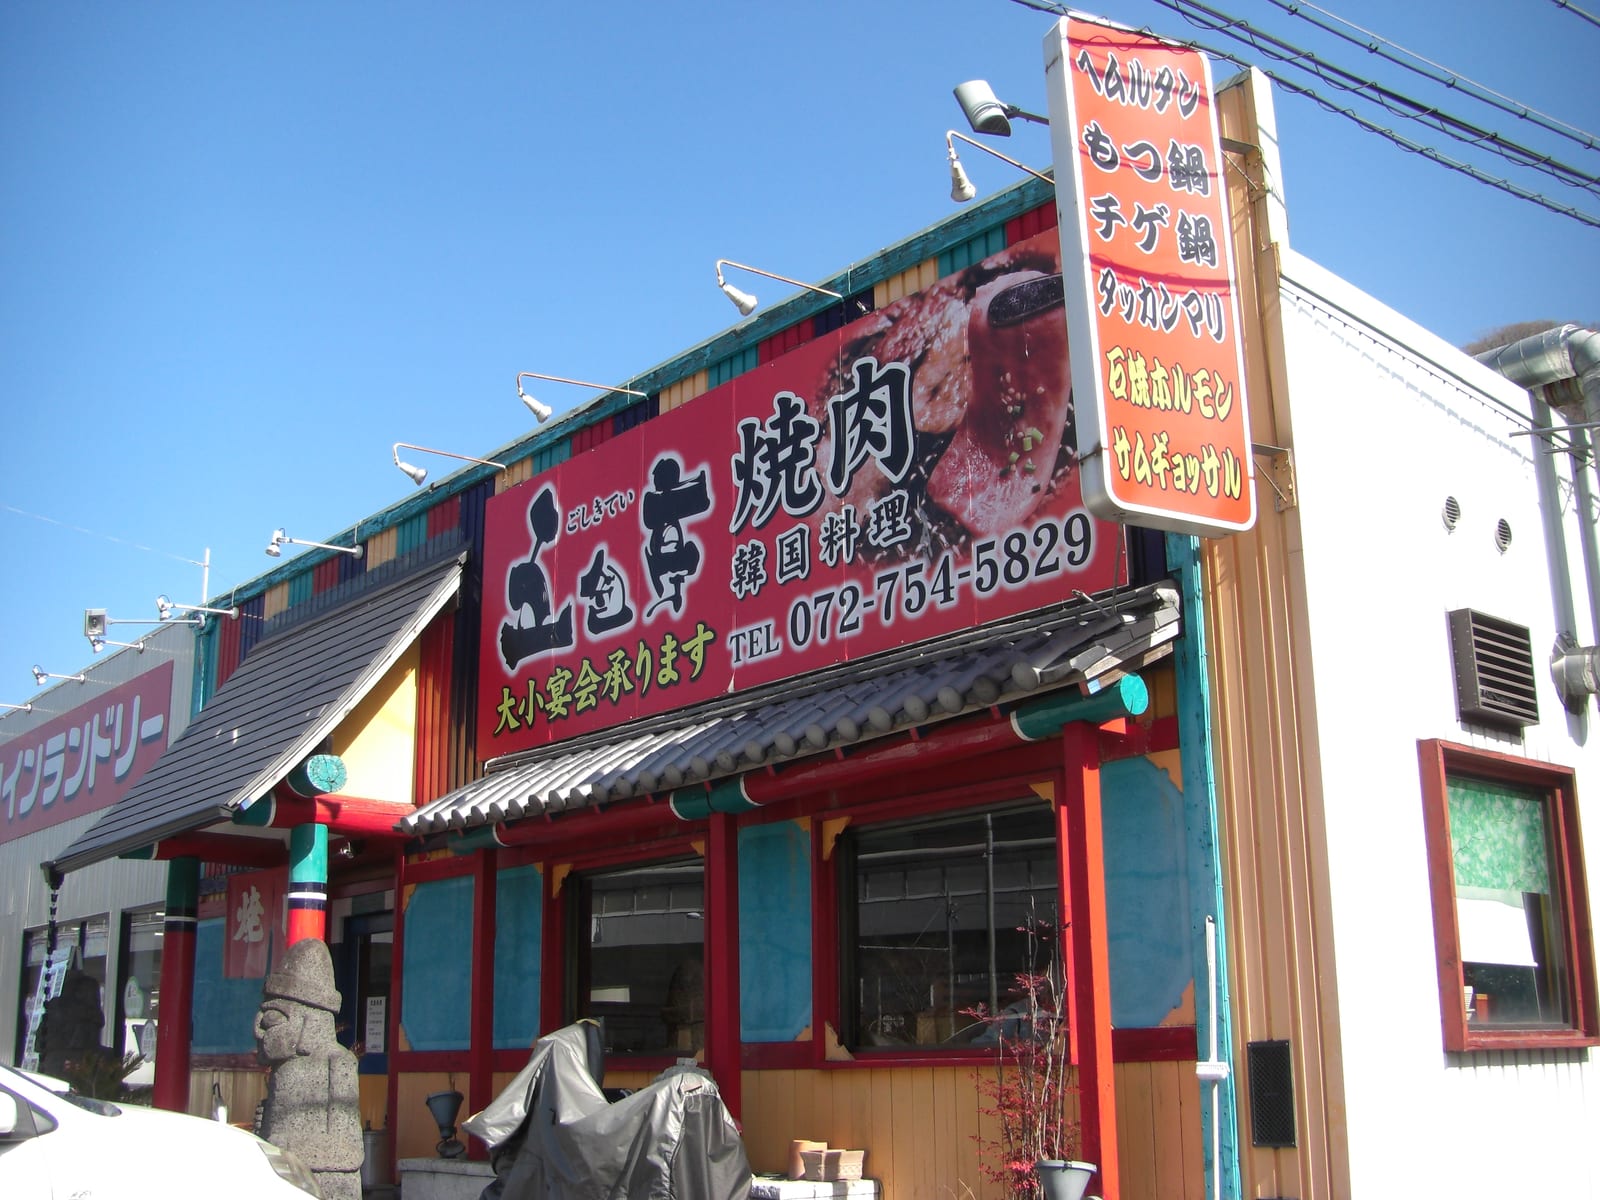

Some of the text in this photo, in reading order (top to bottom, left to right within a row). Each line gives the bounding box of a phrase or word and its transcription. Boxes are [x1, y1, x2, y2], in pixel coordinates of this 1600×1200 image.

[1077, 49, 1199, 118] ヘムルタン
[1083, 120, 1211, 195] もつ鍋
[1090, 194, 1218, 266] チゲ鍋
[1098, 268, 1225, 343] タッカンマリ
[1106, 345, 1232, 421] 石焼ホルモン
[730, 357, 914, 534] 焼肉
[1113, 426, 1242, 500] サムギョッサル
[567, 489, 634, 533] ごしきてい
[731, 490, 910, 600] 韓国料理
[729, 512, 1093, 664] TEL 072-754-5829
[494, 622, 715, 737] 大小宴会承ります
[0, 695, 163, 820] インランドリー
[234, 885, 288, 944] 焼
